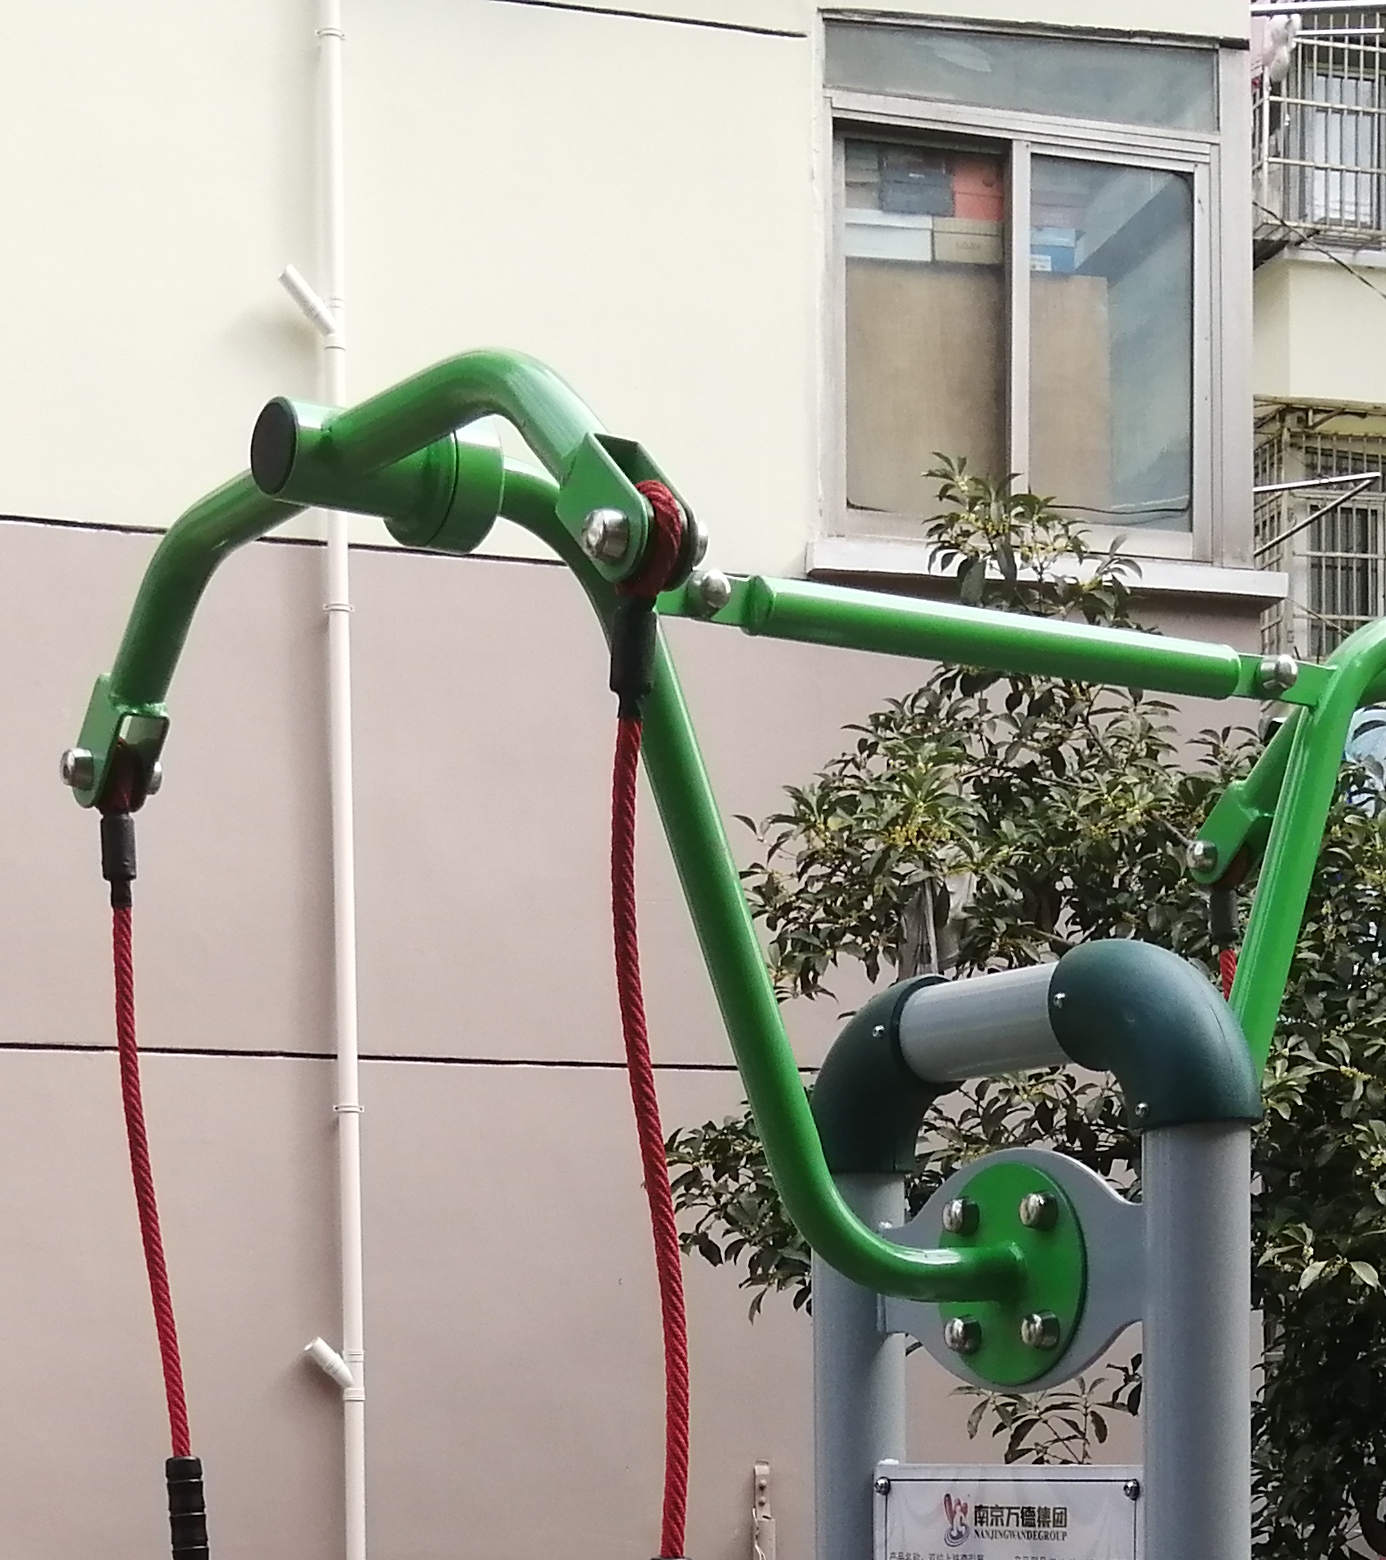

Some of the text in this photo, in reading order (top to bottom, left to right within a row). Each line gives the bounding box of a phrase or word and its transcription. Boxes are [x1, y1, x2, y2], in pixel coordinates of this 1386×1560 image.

[974, 1504, 1067, 1528] 南京万德集团
[974, 1529, 1068, 1541] NANJINGWANDEGROUP
